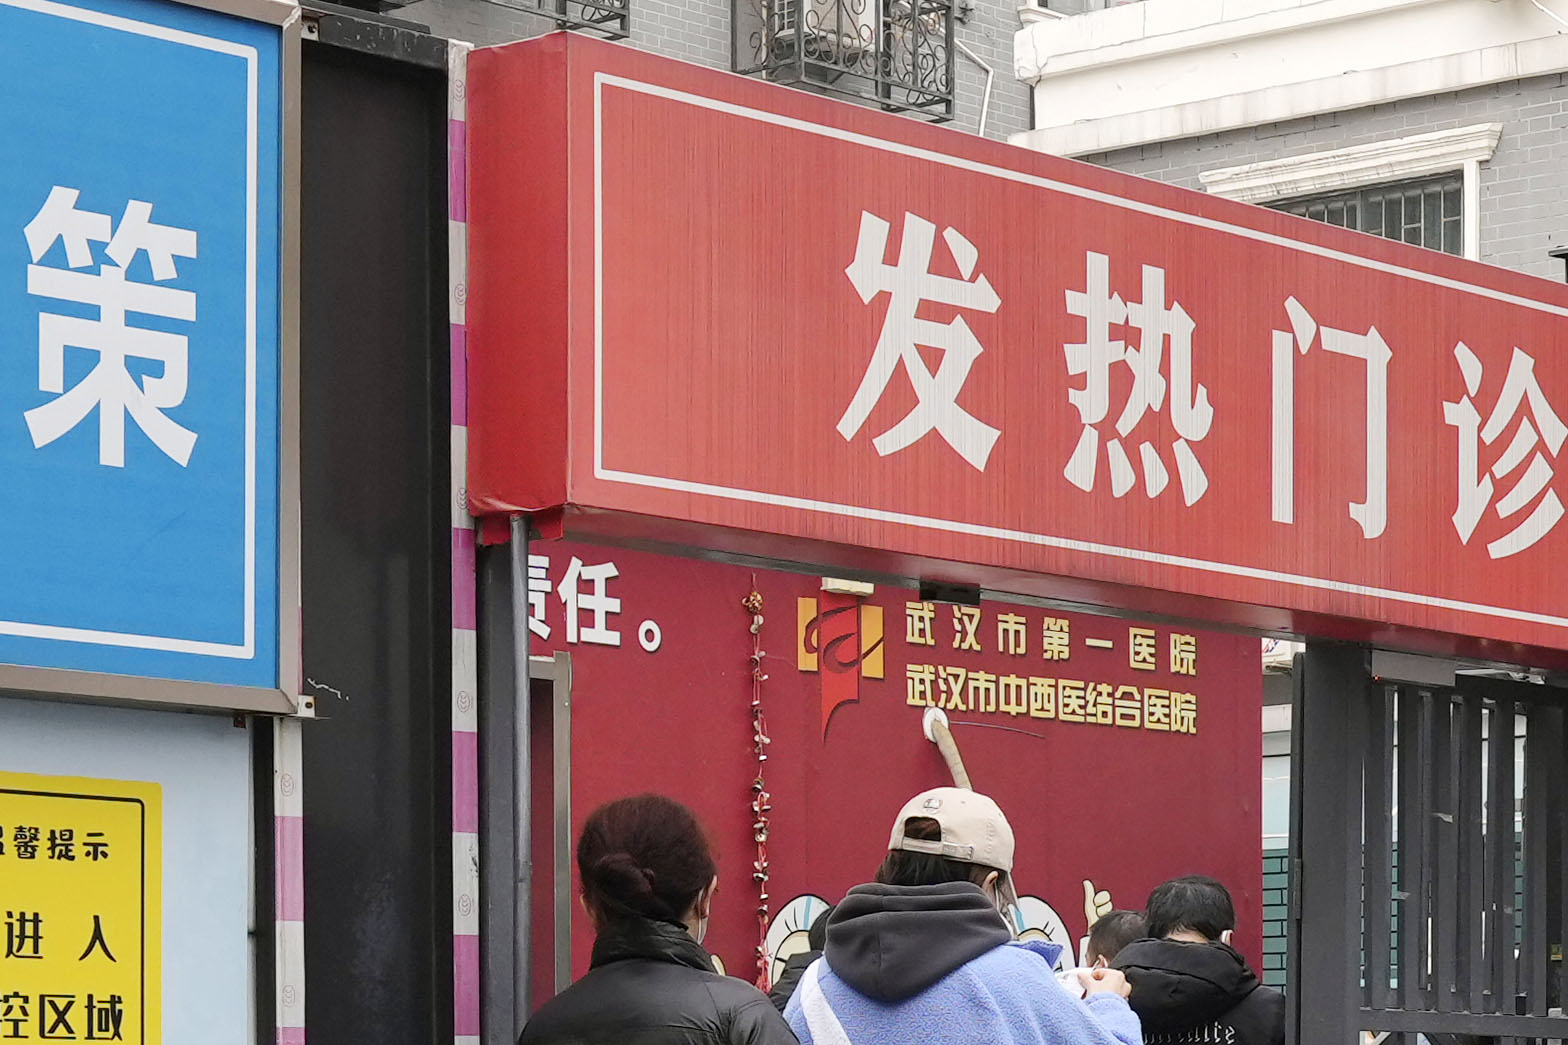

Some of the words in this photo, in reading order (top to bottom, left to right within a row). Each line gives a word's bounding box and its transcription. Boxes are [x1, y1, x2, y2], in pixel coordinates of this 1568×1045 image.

[23, 185, 198, 469] 策
[905, 601, 1197, 676] 武汉市第一医院
[905, 663, 1197, 734] 武汉市中西医结合医院
[0, 825, 109, 862] 馨提示
[0, 991, 124, 1041] 控区域
